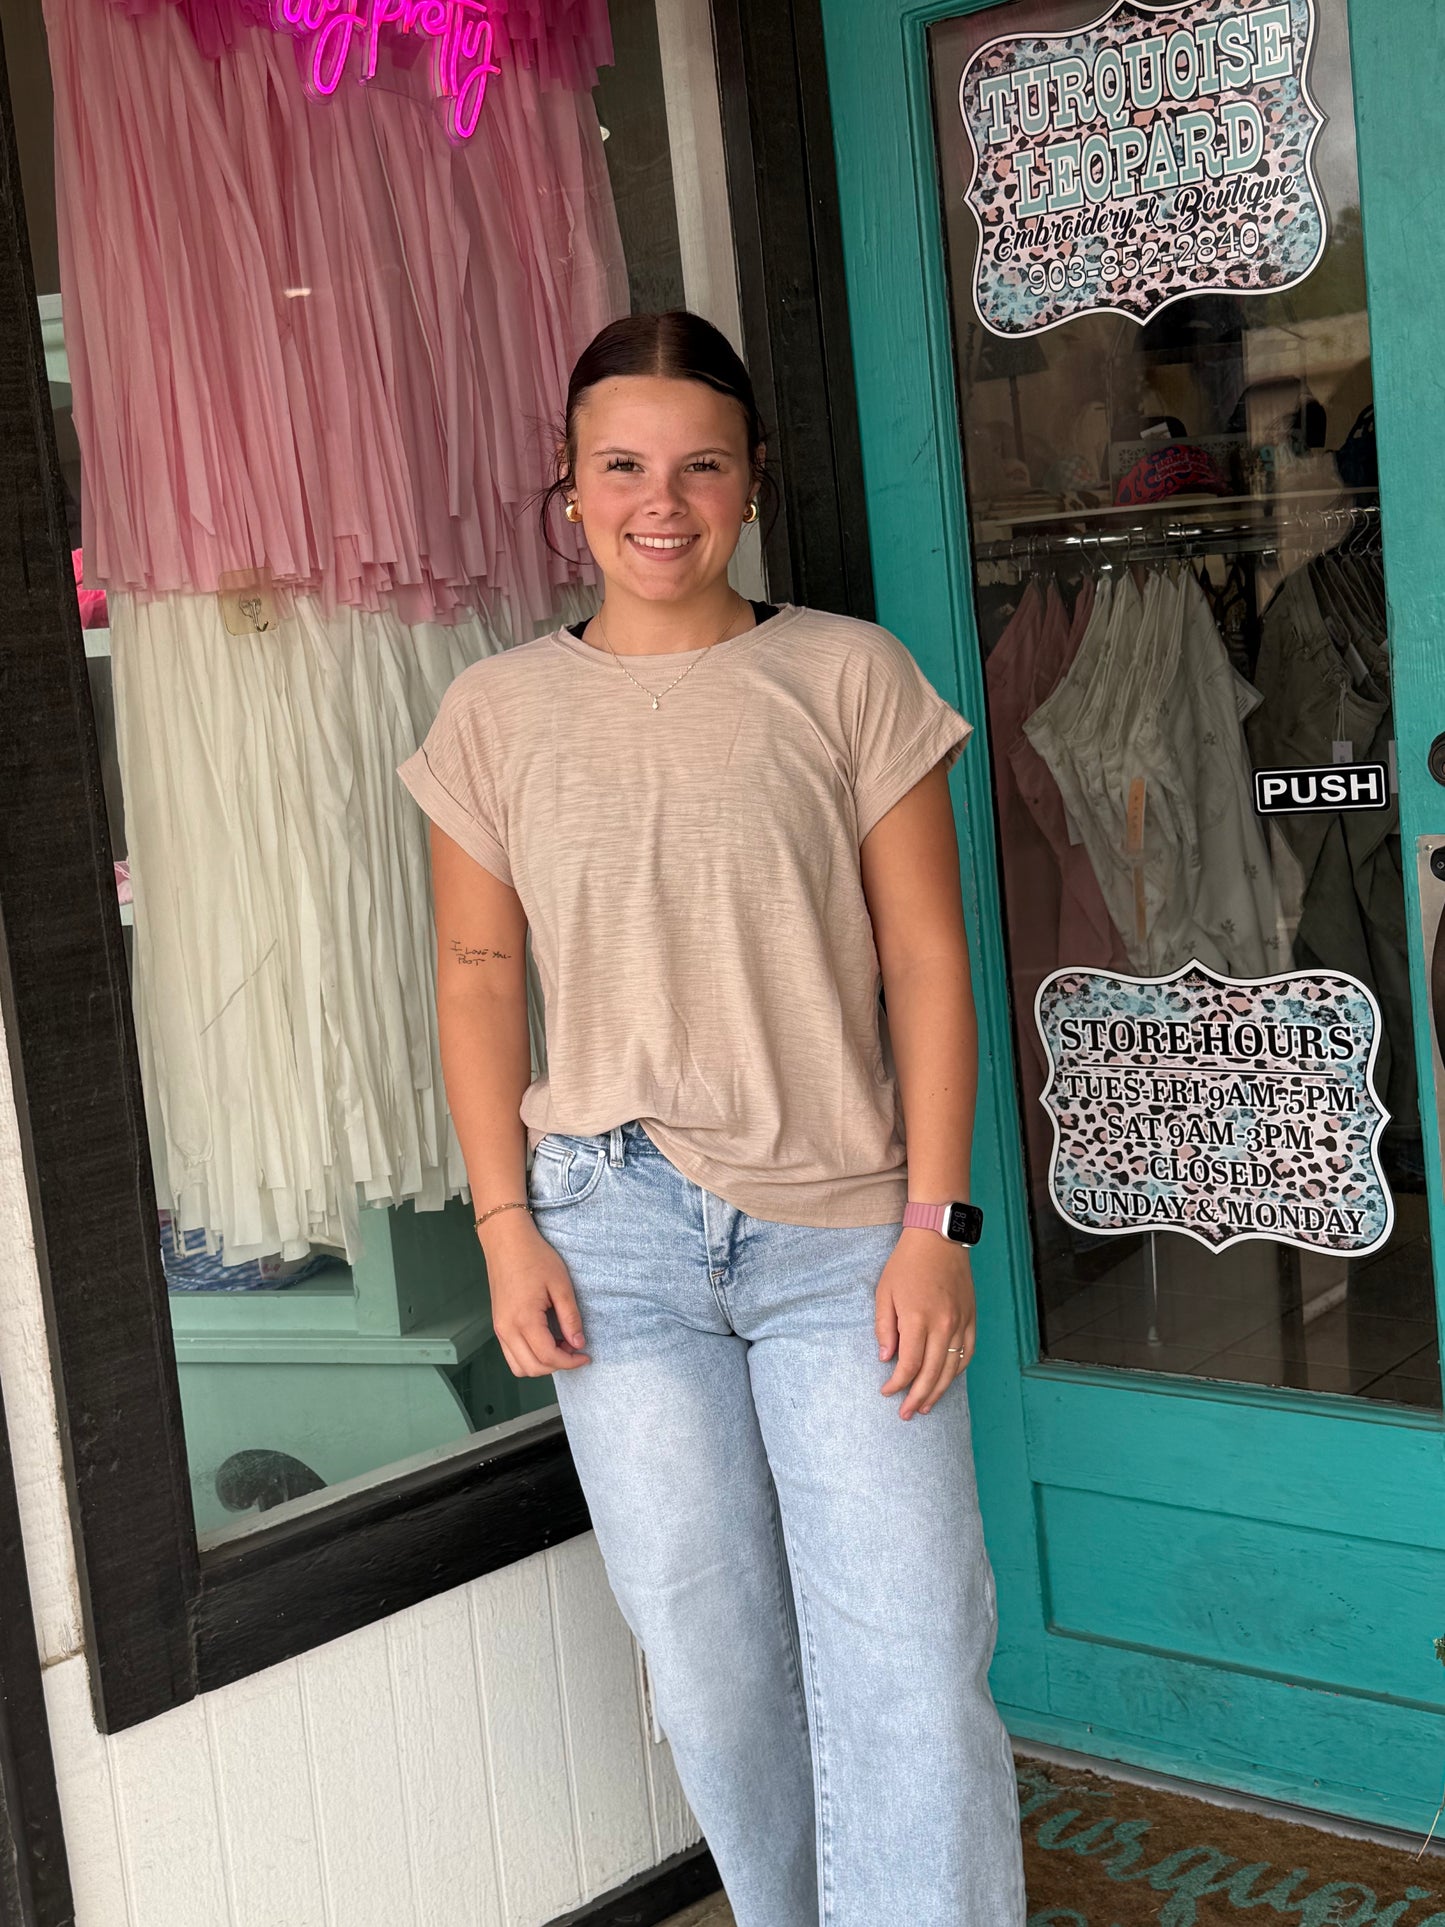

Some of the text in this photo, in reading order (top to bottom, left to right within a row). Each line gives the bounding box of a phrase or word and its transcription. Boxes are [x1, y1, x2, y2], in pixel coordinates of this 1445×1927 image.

[979, 5, 1294, 145] TURQUOISE
[1012, 100, 1266, 221] LEOPARD
[994, 172, 1297, 265] Embroidery & Boutique
[1027, 221, 1261, 296] 903-852-2840
[1263, 773, 1377, 805] PUSH
[450, 940, 462, 951] I
[1059, 1018, 1354, 1061] STORE HOURS
[1064, 1074, 1357, 1115] TUES-FRI 9AM-5PM
[1107, 1114, 1314, 1153] SAT 9AM-3PM
[1149, 1156, 1272, 1188] CLOSED
[1072, 1188, 1366, 1236] SUNDAY & MONDAY
